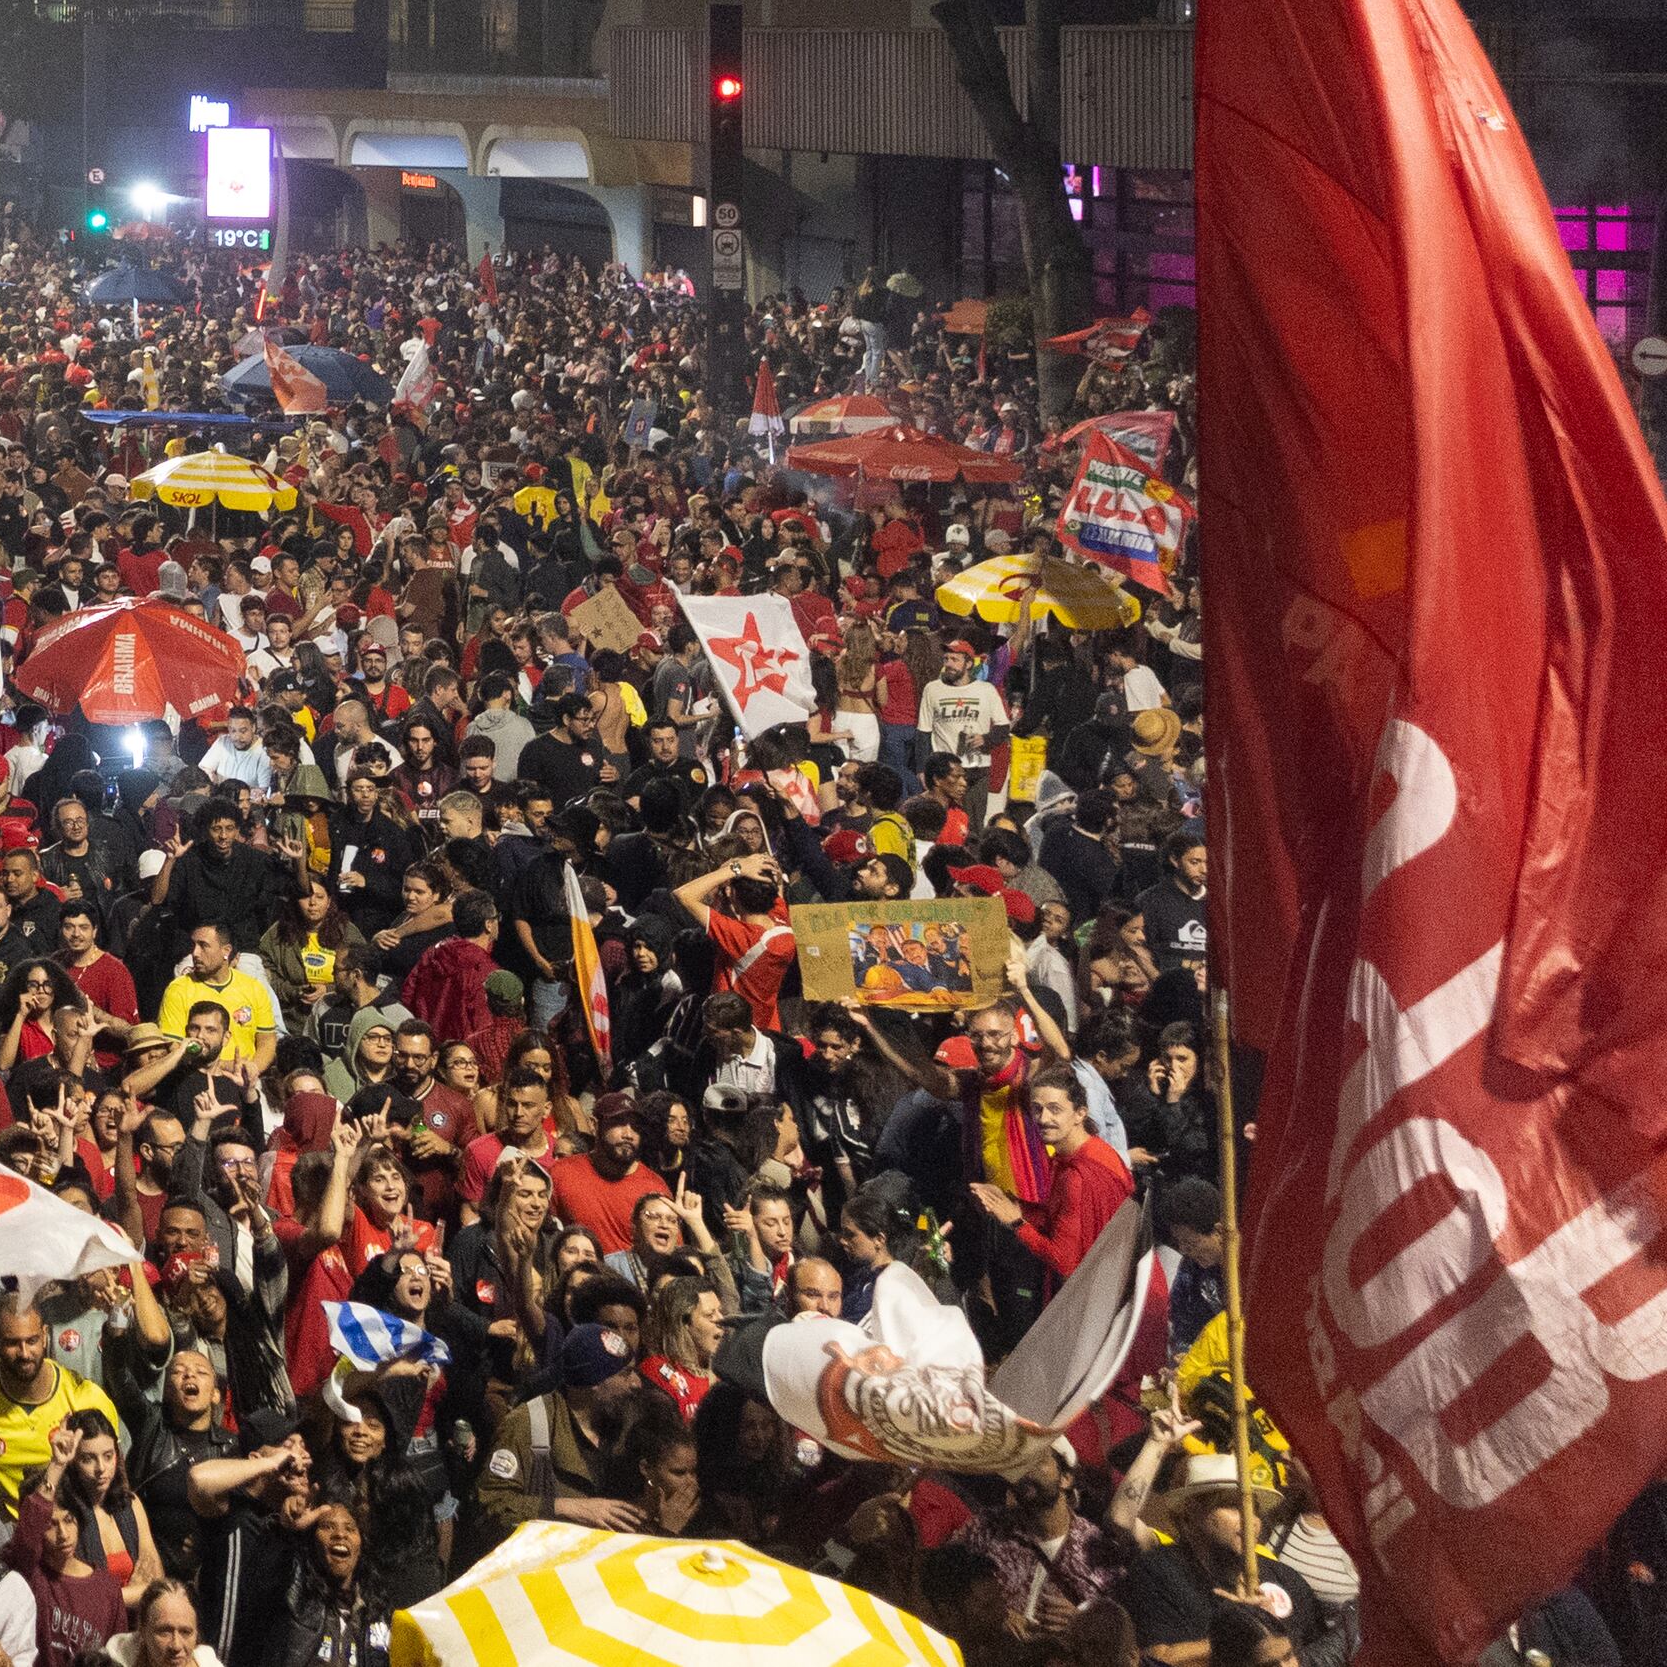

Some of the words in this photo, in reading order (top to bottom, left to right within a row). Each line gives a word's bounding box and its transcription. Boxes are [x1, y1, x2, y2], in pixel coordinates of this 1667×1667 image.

[718, 208, 736, 220] 50
[215, 229, 258, 248] 19°C
[170, 491, 202, 505] SKOL
[169, 614, 229, 656] BRAHMA
[113, 633, 137, 695] BRAHMA
[188, 692, 221, 715] BRAHMA
[941, 706, 980, 720] Lula
